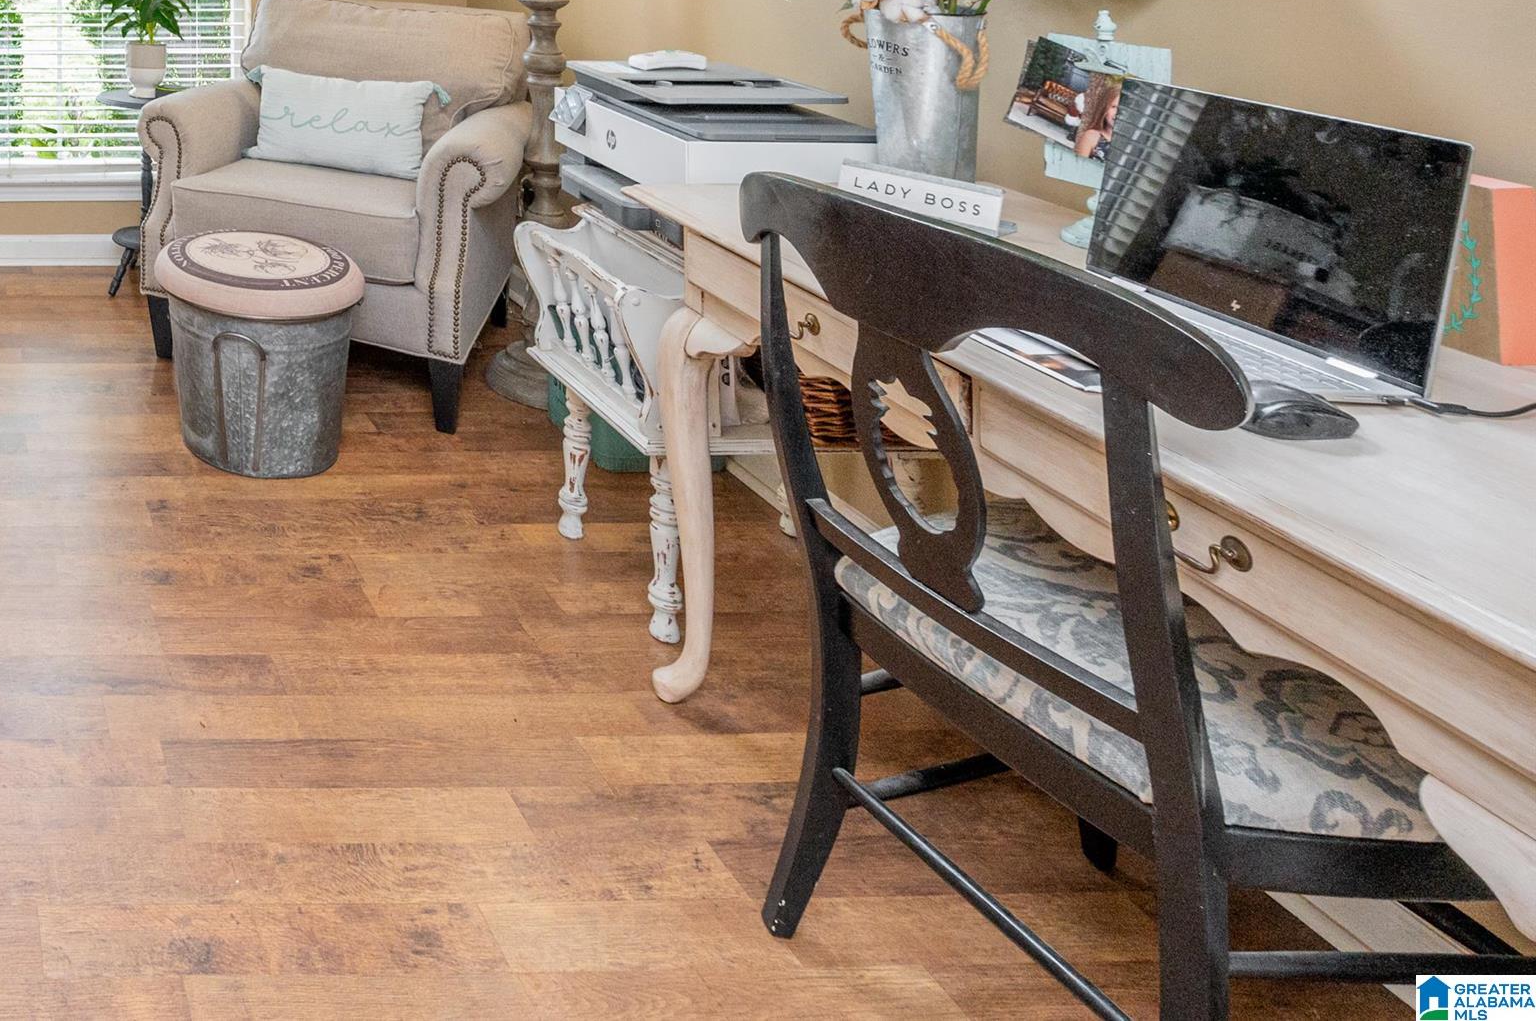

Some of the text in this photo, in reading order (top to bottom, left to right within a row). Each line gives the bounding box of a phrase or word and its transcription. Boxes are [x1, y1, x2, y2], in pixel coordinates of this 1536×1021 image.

[867, 38, 910, 57] LOWERS
[261, 105, 420, 138] relax
[854, 176, 981, 216] LADY BOSS
[281, 259, 345, 287] PERCENT
